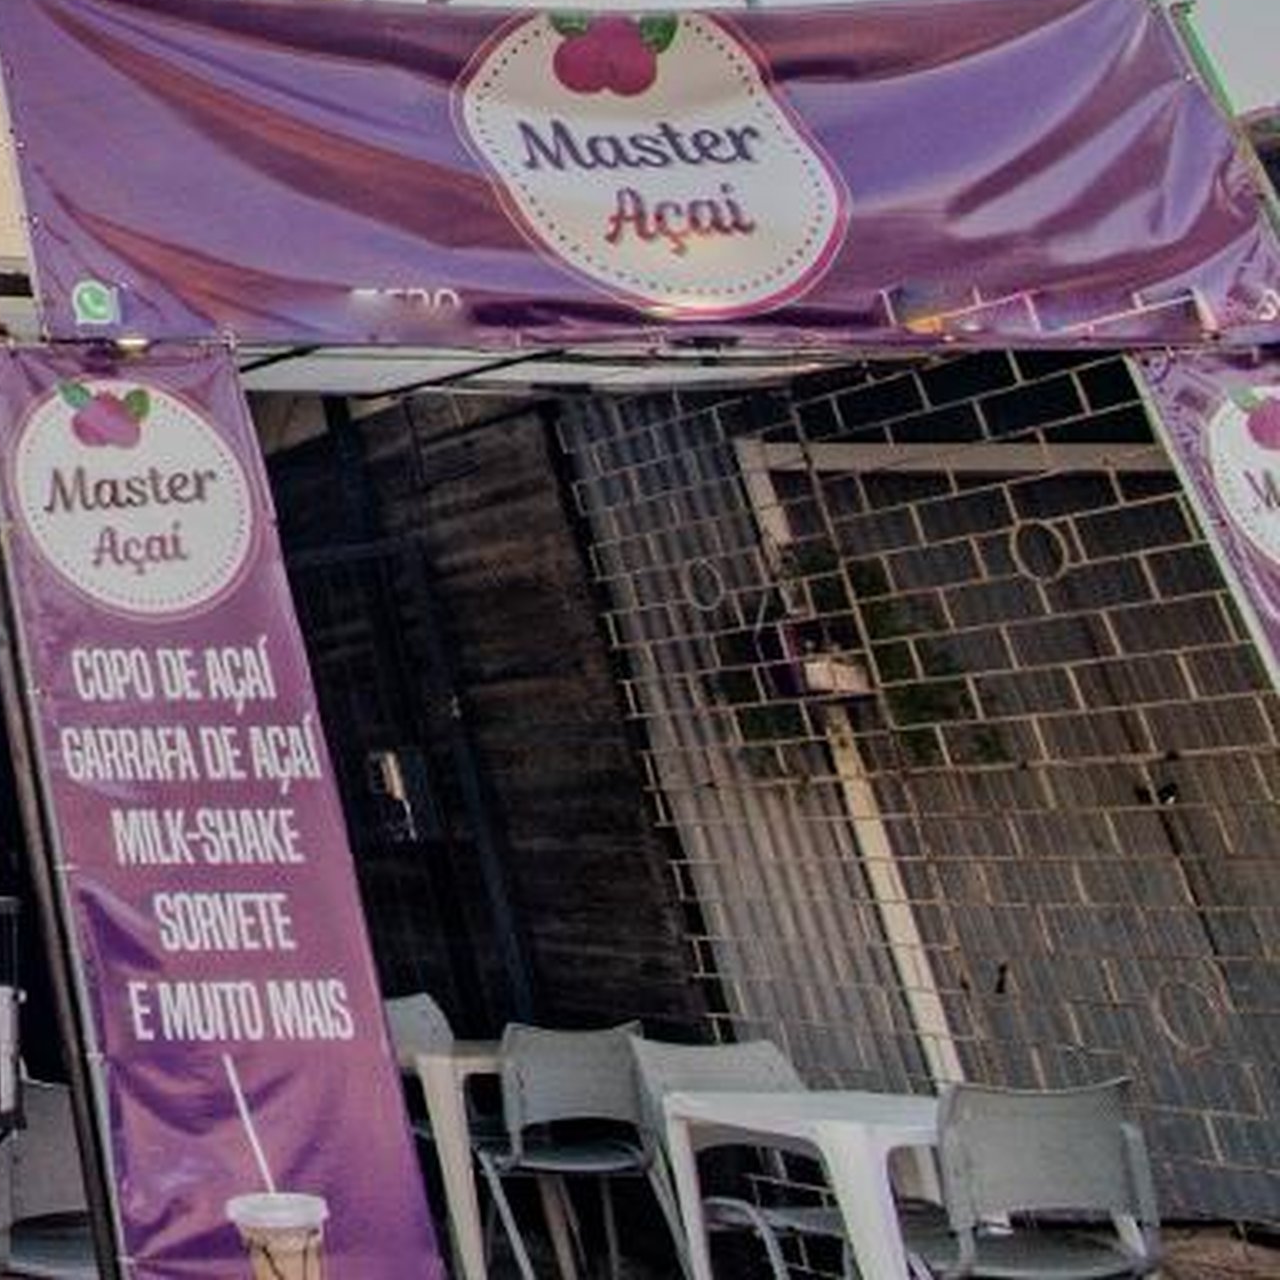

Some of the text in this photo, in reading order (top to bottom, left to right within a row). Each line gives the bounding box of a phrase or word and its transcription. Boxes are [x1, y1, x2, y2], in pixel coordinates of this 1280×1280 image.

[517, 120, 760, 169] Master
[43, 466, 217, 513] Master
[72, 635, 277, 715] COPO DE AÇAÍ
[60, 713, 323, 795] GARRAFA DE AÇAÍ
[110, 808, 306, 865] MILK-SHAKE
[153, 892, 296, 951] SORVETE
[128, 977, 355, 1041] E MUITO MAIS
